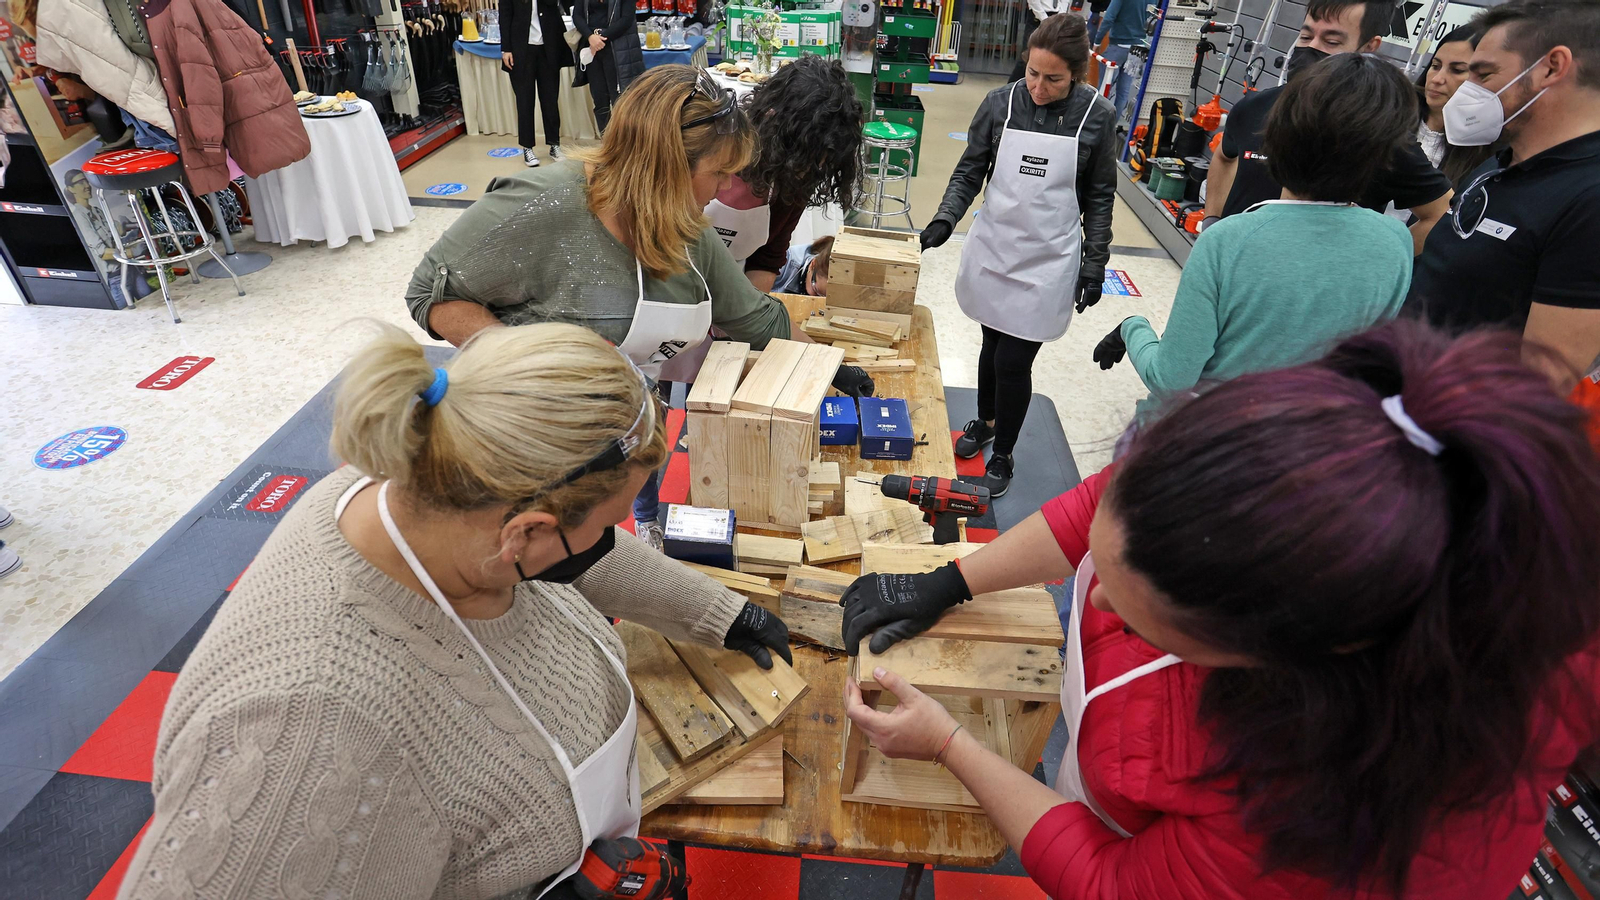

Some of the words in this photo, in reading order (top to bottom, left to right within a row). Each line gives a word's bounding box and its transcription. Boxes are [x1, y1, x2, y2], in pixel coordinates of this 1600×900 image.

[1020, 166, 1045, 176] OXIRITE
[13, 204, 45, 213] Einhell
[48, 270, 78, 278] Einhell
[152, 357, 202, 388] TORO
[61, 434, 120, 461] 15%
[246, 471, 272, 493] Count
[235, 492, 249, 503] on
[260, 478, 298, 509] TORO
